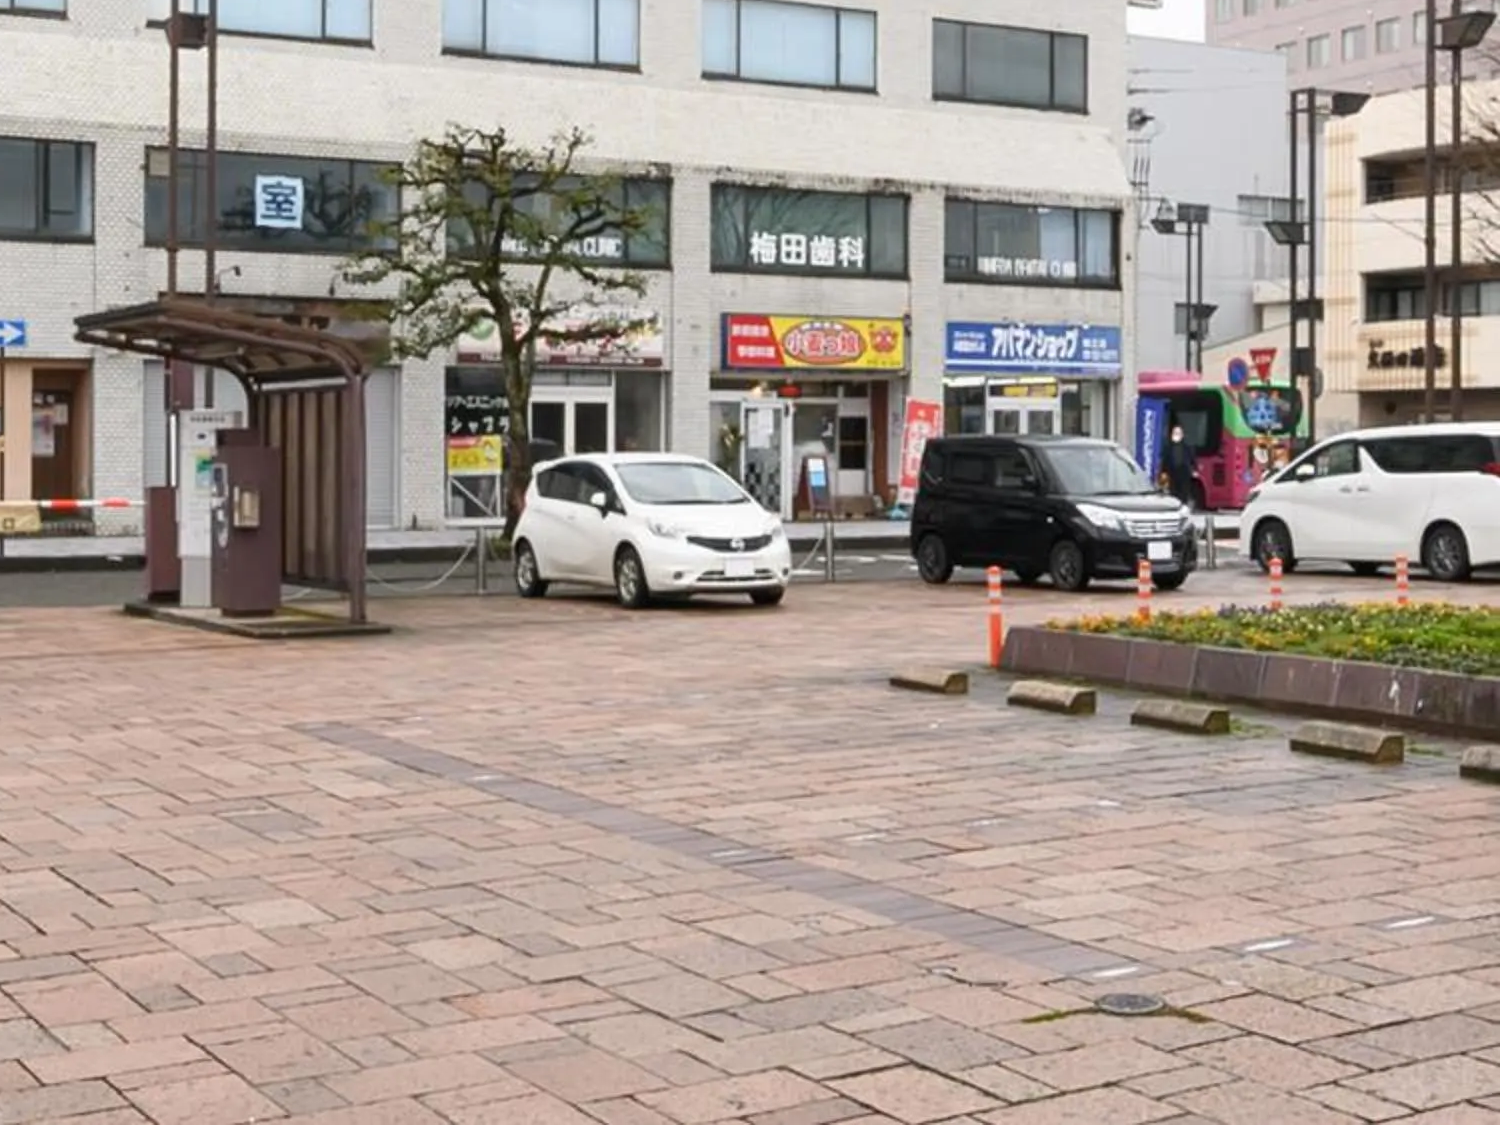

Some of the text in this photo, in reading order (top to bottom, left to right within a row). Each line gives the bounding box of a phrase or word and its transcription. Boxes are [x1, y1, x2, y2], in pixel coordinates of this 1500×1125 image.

[260, 180, 297, 221] 室
[750, 230, 864, 268] 梅田歯科
[991, 324, 1079, 358] アパマンショップ
